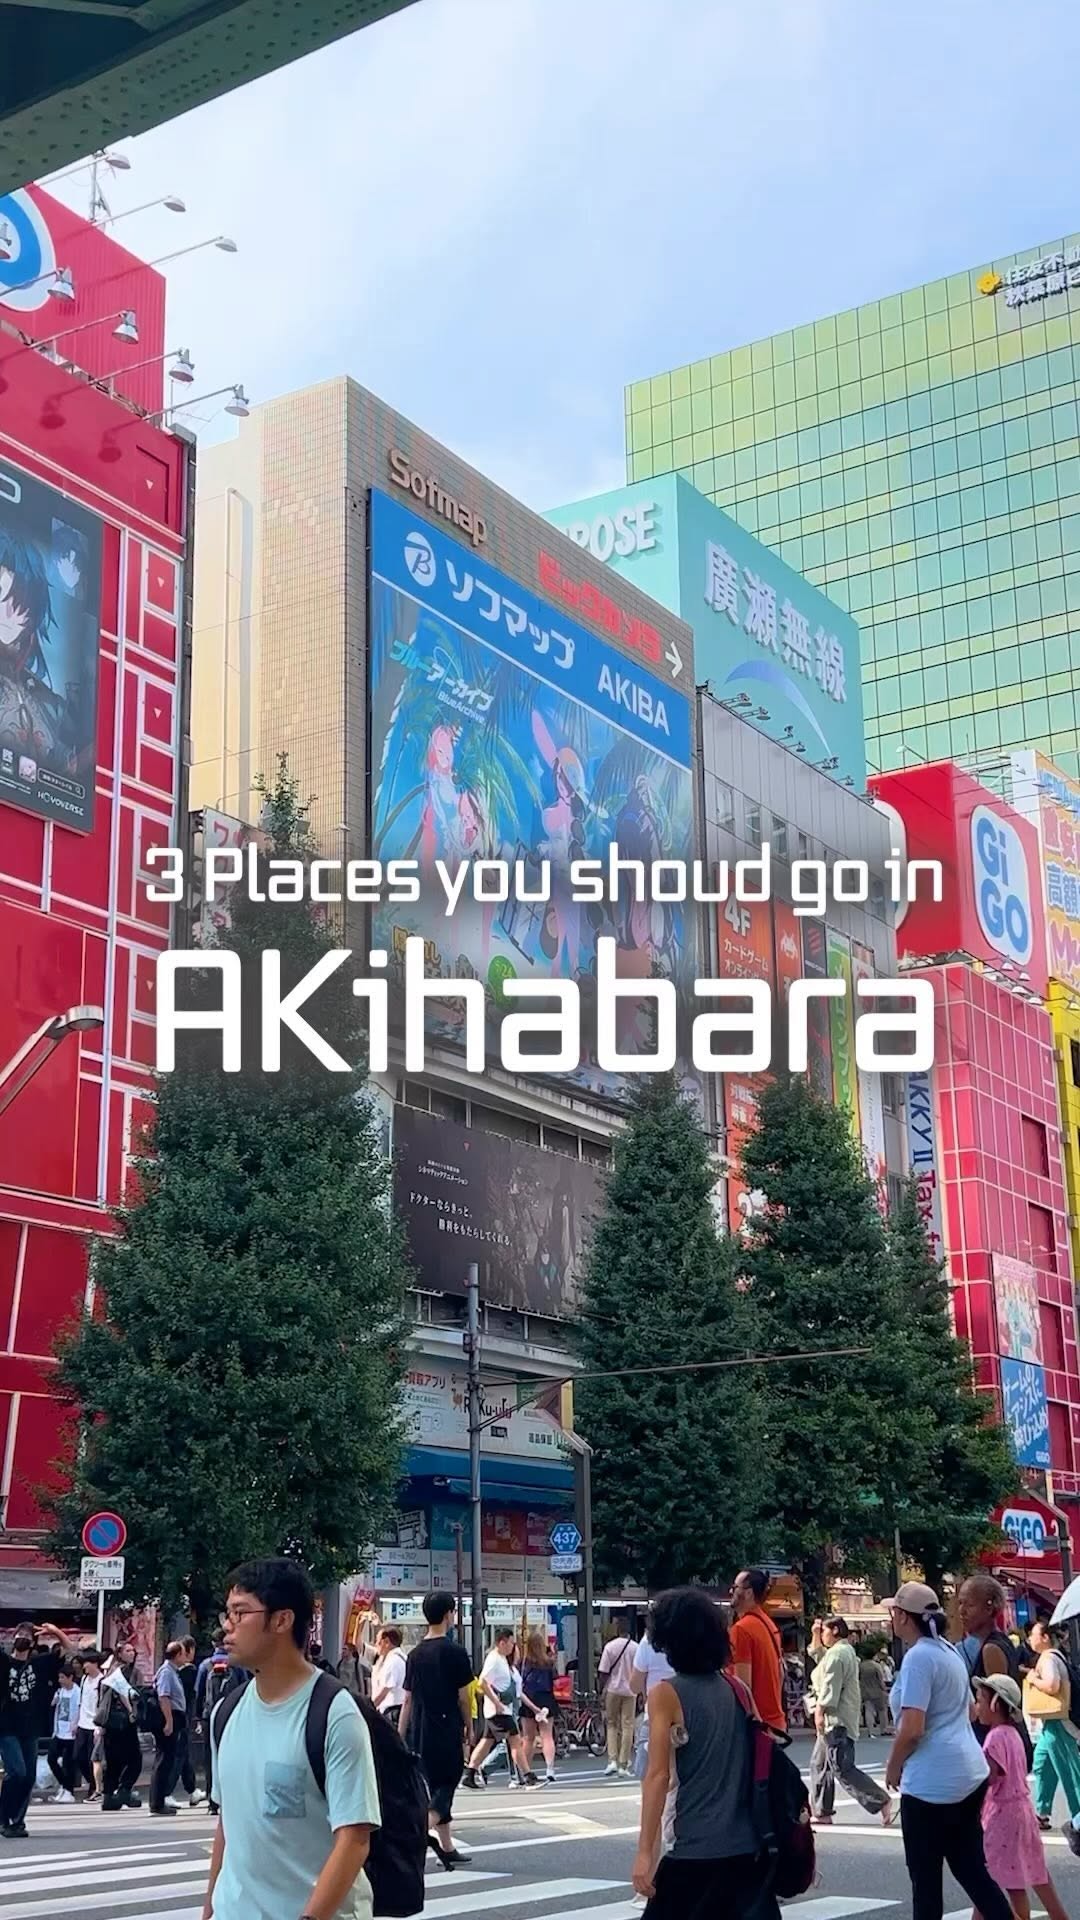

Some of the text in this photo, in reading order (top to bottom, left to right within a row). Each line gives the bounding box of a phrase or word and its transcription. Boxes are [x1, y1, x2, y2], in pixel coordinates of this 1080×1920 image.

[391, 449, 486, 546] Sofmap
[445, 559, 575, 669] ソフマップ
[597, 664, 671, 736] AKIBA
[725, 891, 751, 937] 4F
[553, 1532, 577, 1544] 437
